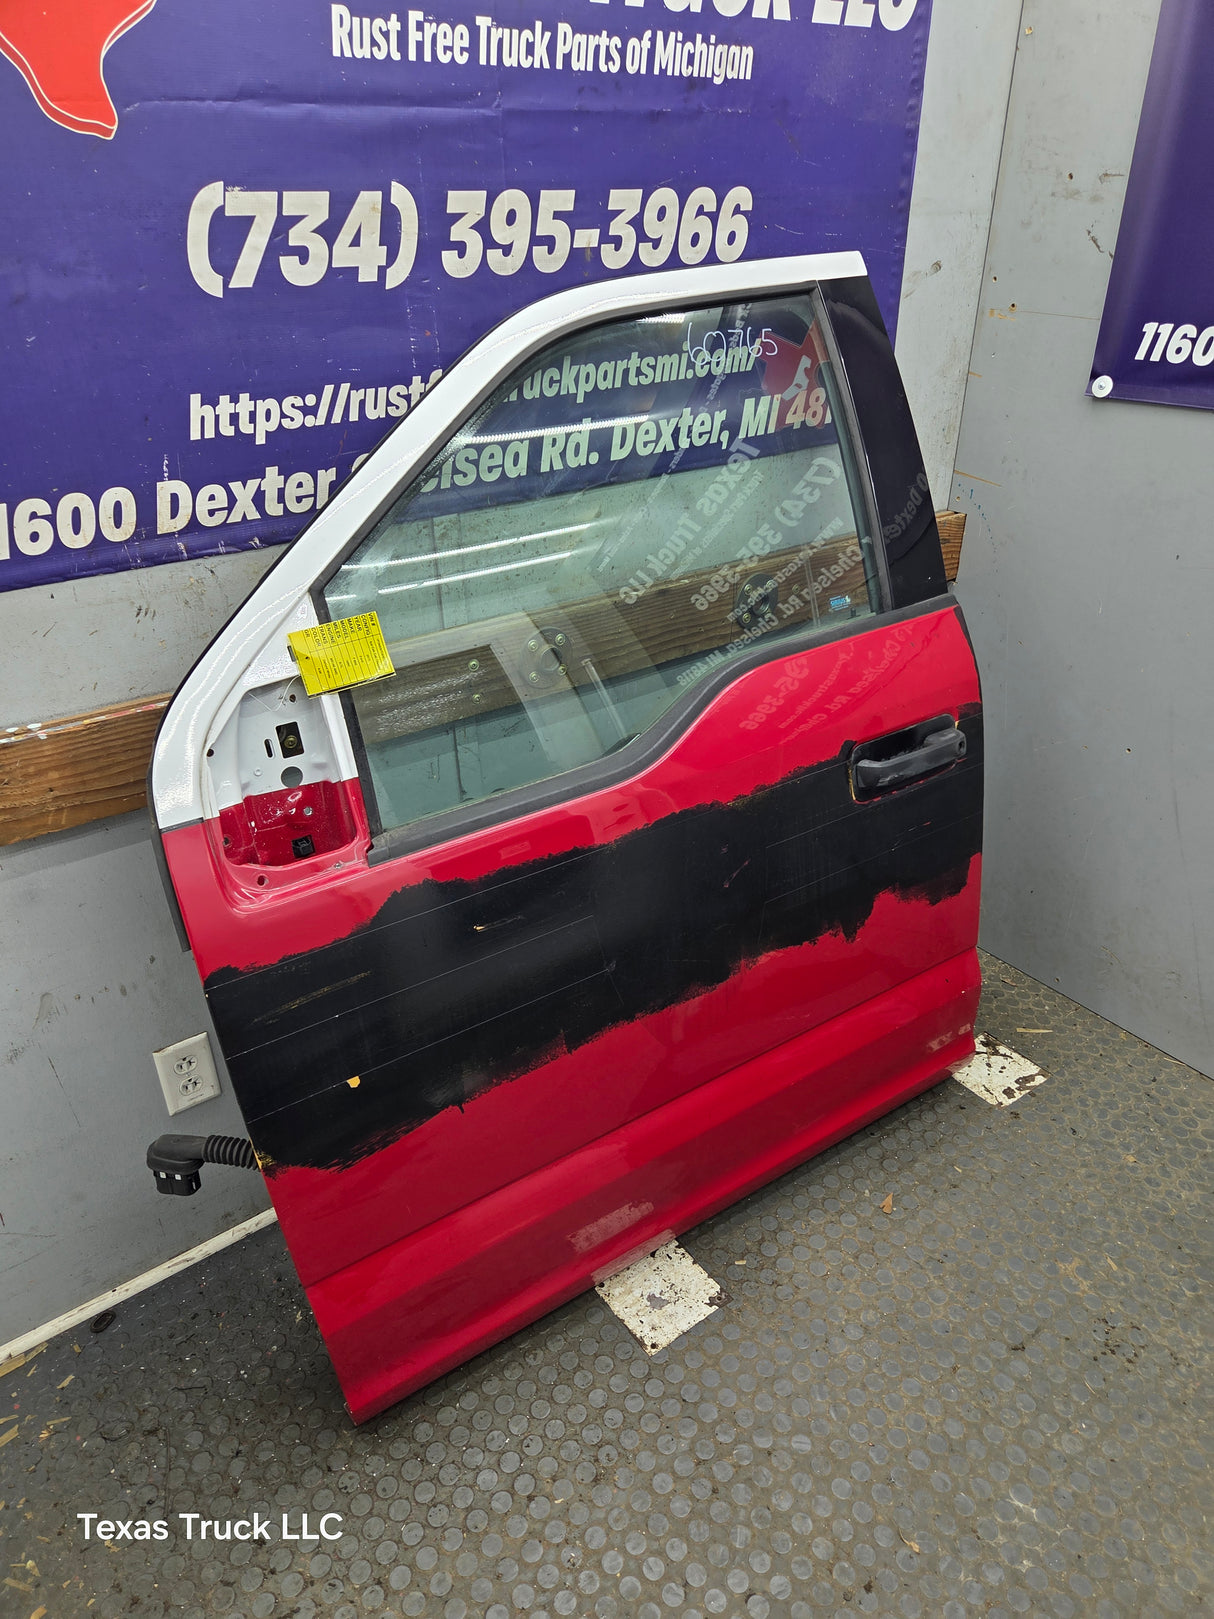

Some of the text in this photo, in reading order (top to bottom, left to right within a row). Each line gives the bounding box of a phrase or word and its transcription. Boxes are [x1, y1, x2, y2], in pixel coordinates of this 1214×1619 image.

[331, 4, 754, 85] Rust Free Truck Parts of Michigan
[187, 181, 753, 298] (734) 395-3966
[156, 465, 336, 535] Dexter
[540, 417, 600, 473] Rd.
[610, 407, 729, 462] Dexter,
[739, 394, 782, 439] MI
